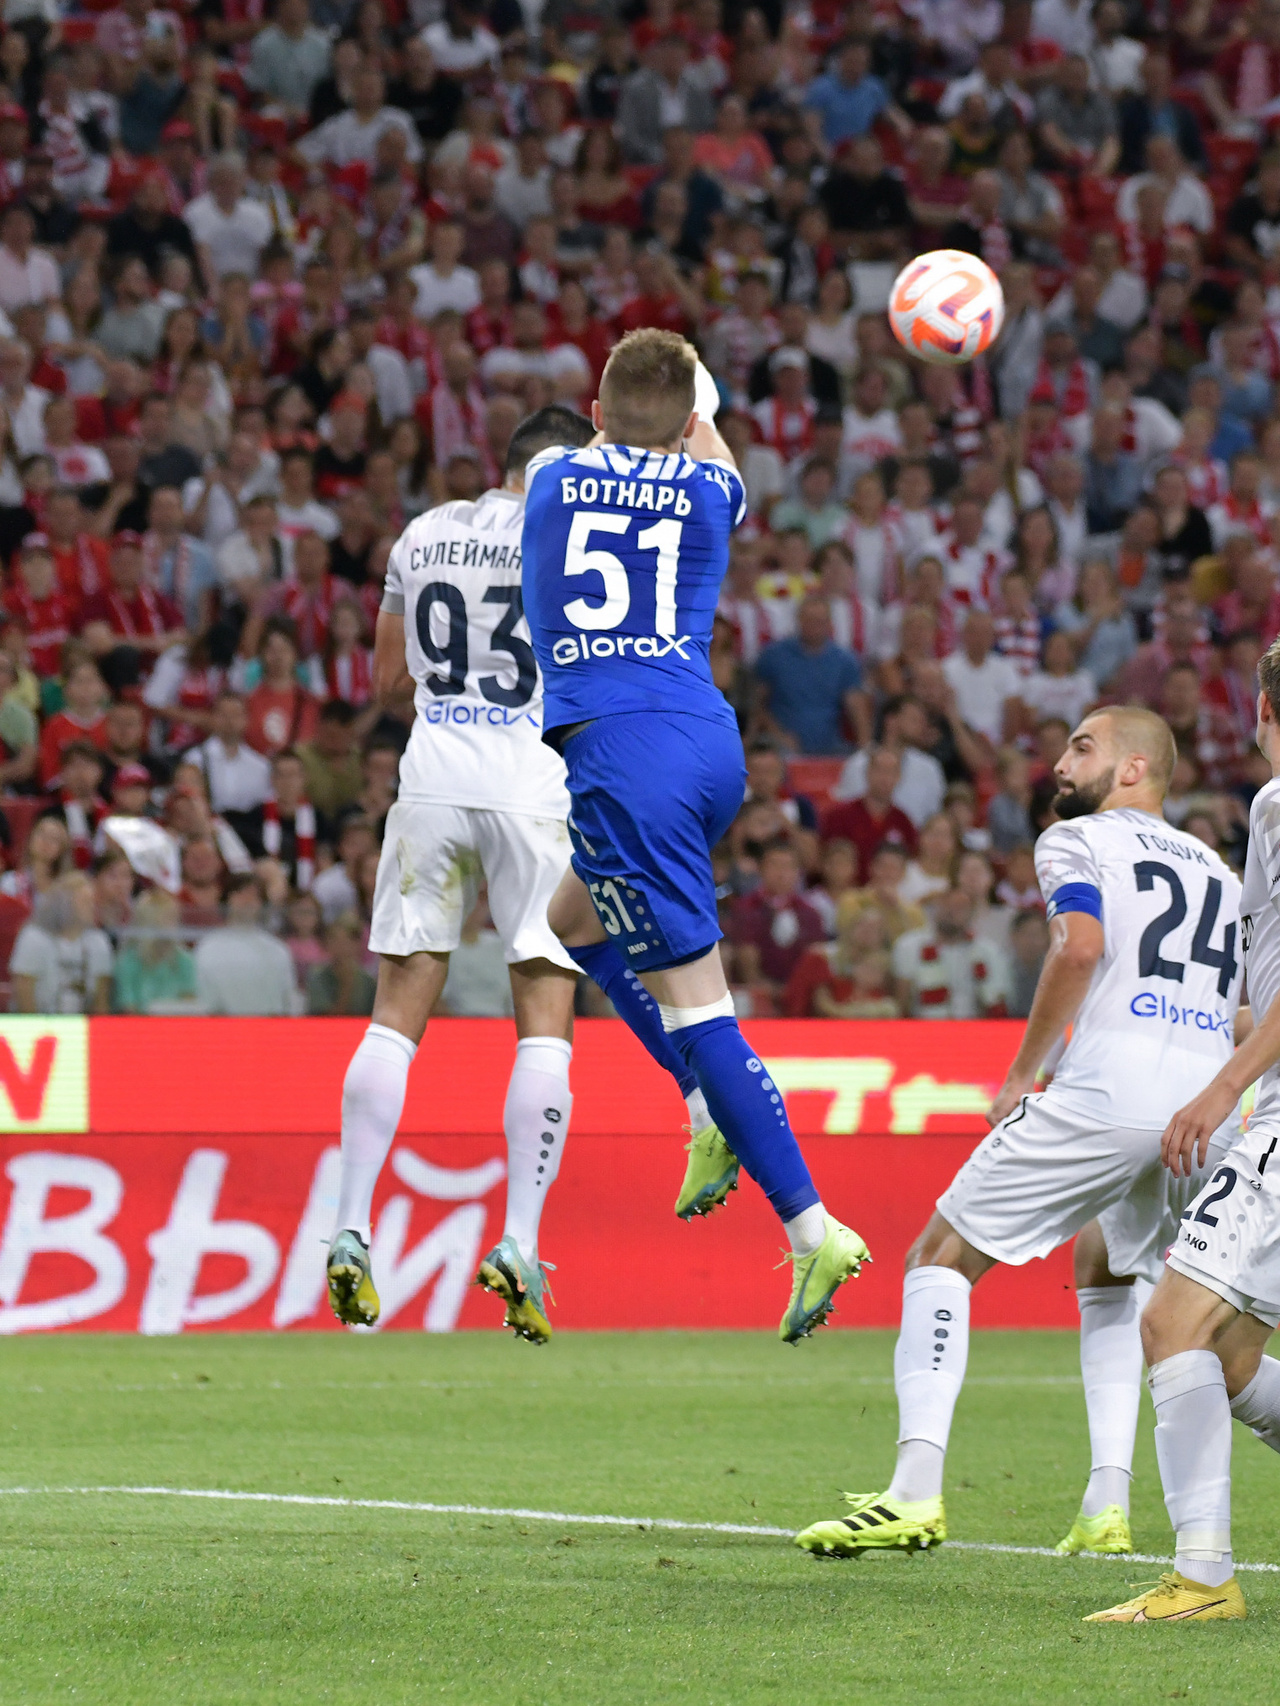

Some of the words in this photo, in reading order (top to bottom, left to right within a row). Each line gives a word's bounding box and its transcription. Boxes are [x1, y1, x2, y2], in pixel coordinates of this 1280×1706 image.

[561, 477, 692, 517] БОТНАРЬ
[563, 511, 683, 636] 51
[416, 582, 537, 708] 93
[1136, 833, 1210, 867] ГОЦУК
[589, 880, 637, 936] 51
[1133, 860, 1238, 999] 24
